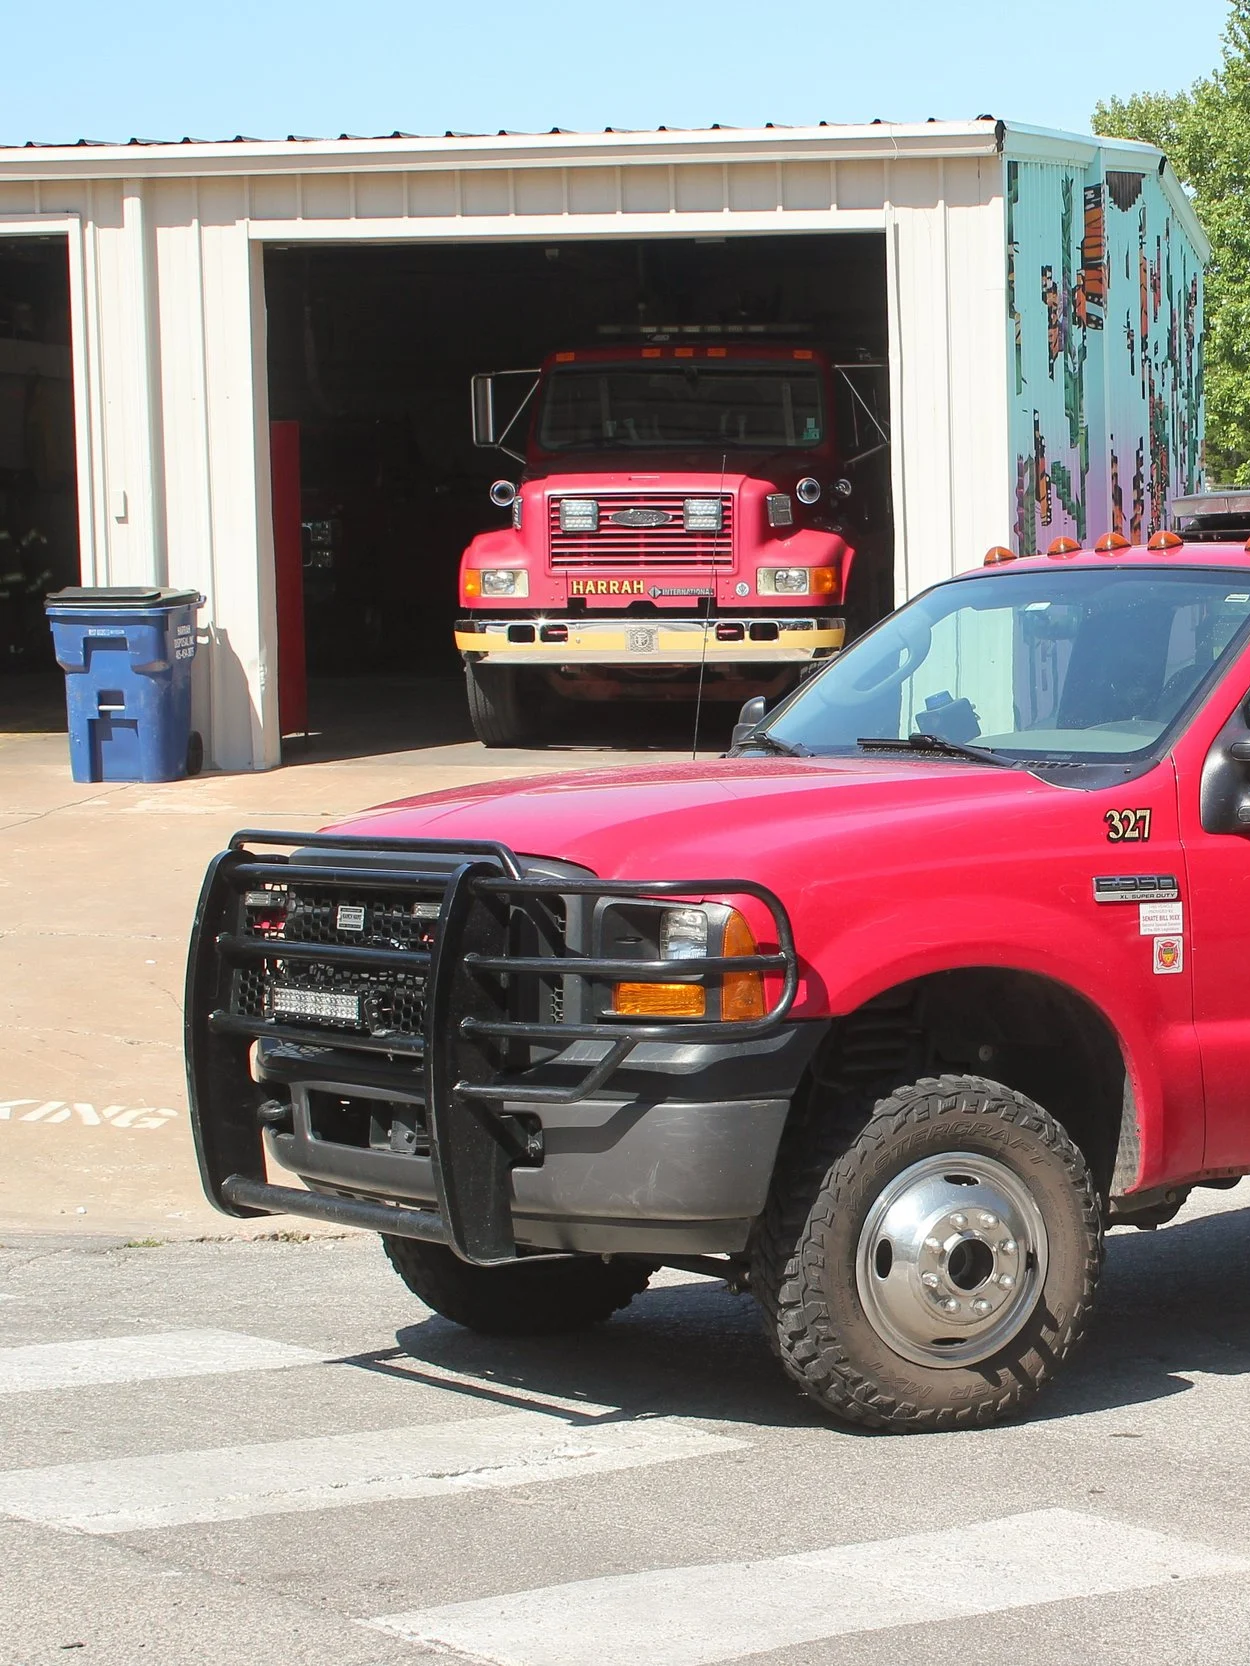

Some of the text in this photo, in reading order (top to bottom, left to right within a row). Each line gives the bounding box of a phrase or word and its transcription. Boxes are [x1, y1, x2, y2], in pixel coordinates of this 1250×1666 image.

[572, 580, 645, 595] HARRAH
[661, 588, 714, 596] INTERNATIONAL
[1105, 808, 1152, 842] 327
